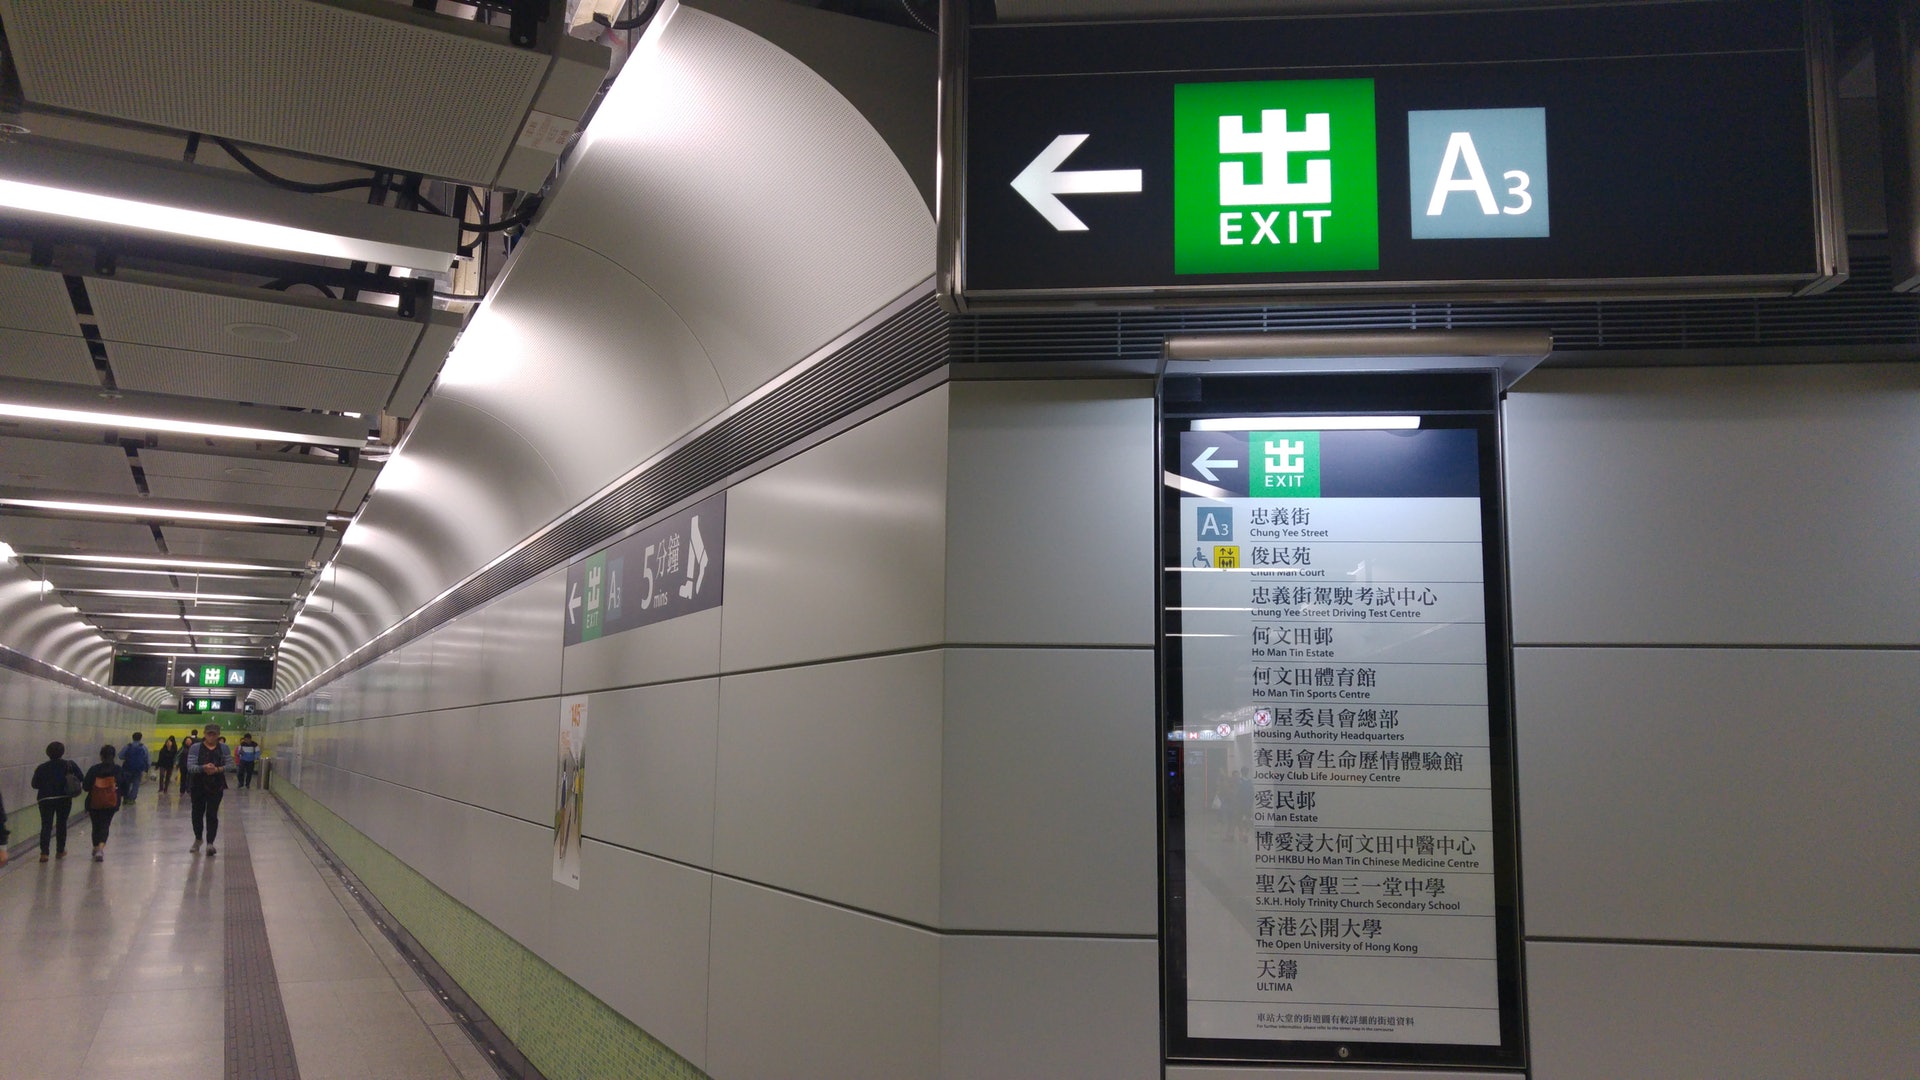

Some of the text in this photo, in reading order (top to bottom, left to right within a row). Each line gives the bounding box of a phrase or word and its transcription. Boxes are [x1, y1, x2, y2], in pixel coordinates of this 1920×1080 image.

[1219, 108, 1332, 206] 出
[1426, 131, 1533, 217] A3
[1219, 209, 1332, 246] EXIT
[1265, 439, 1304, 473] 出
[1265, 475, 1304, 487] EXIT
[1201, 513, 1229, 536] A3
[1250, 507, 1310, 526] 忠義街
[1250, 528, 1329, 539] Chung Yee Street
[1250, 546, 1311, 565] 俊民苑
[641, 532, 680, 610] 5 分鐘
[1299, 568, 1325, 577] Court
[587, 566, 601, 611] 出
[607, 570, 621, 611] A3
[1251, 586, 1438, 606] 忠義街駕駛考試中心
[653, 589, 668, 609] mins
[586, 611, 599, 629] EXIT
[1251, 608, 1421, 619] Chung Yee Street Driving Test Centre
[1252, 626, 1333, 646] 何文田邨
[1252, 649, 1334, 657] Ho Man Tin Estate
[229, 671, 243, 683] A3
[1252, 666, 1376, 687] 何文田體育館
[1252, 689, 1371, 700] Ho Man Tin Sports Centre
[1254, 730, 1405, 742] Housing Authority Headquarters
[1254, 770, 1400, 784] Jockey Club Life Journey Centre
[1254, 789, 1316, 810] 愛民邨
[1254, 812, 1318, 823] Oi Man Estate
[1255, 831, 1476, 856] 博愛浸大何文田中醫中心
[1255, 854, 1480, 869] POH HKBU Ho Man Tin Chinese Medicine Centre
[1255, 873, 1446, 898] 聖公會聖三一堂中學
[1255, 897, 1460, 911] S.K.H. Holy Trinity Church Secondary School
[1256, 916, 1382, 939] 香港公開大學
[1256, 939, 1418, 955] The Open University of Hong Kong
[1256, 959, 1298, 980] 天鑄
[1256, 982, 1293, 992] ULTIMA
